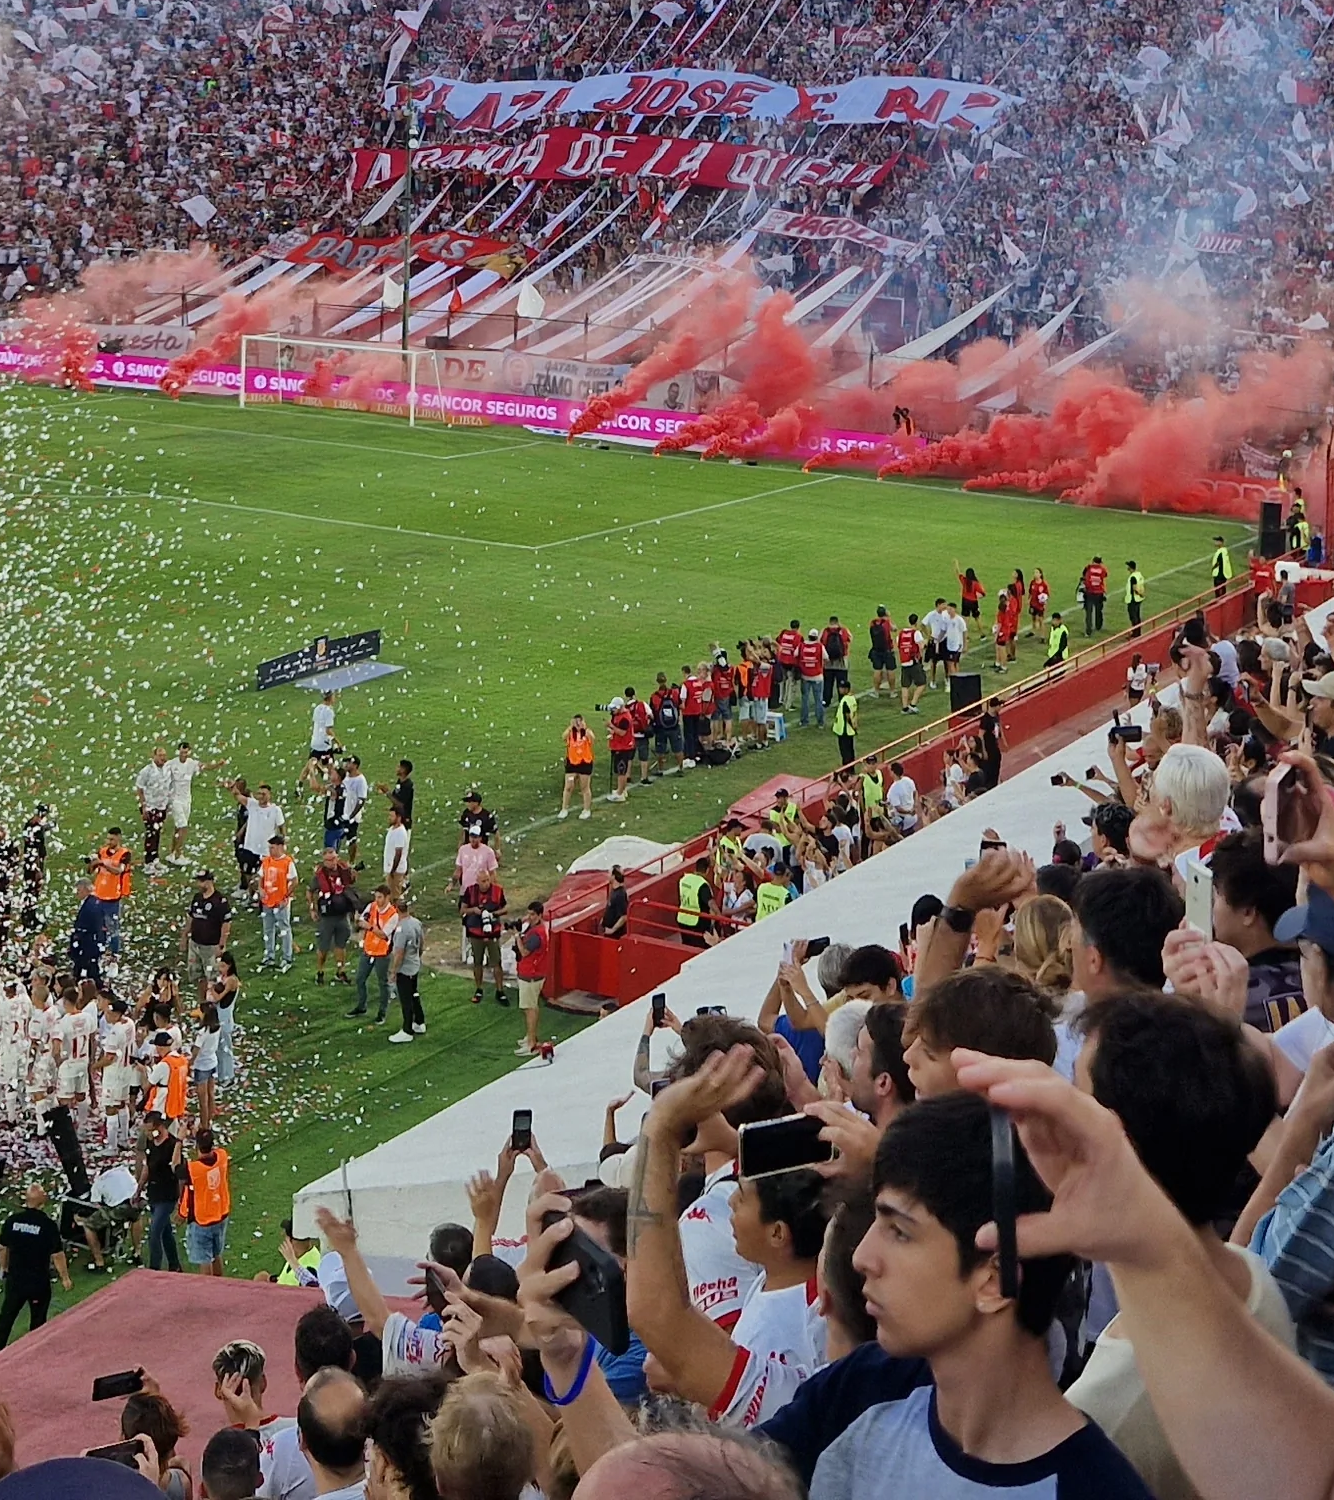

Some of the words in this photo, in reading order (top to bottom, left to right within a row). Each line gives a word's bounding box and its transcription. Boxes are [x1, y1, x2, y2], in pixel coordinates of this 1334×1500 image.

[594, 75, 774, 117] JOSE
[557, 132, 638, 177] DE
[637, 137, 714, 181] LA
[376, 404, 404, 416] LIBRA
[422, 393, 483, 414] SANCOR
[486, 400, 557, 421] SEGUROS
[451, 415, 484, 427] LIBRA
